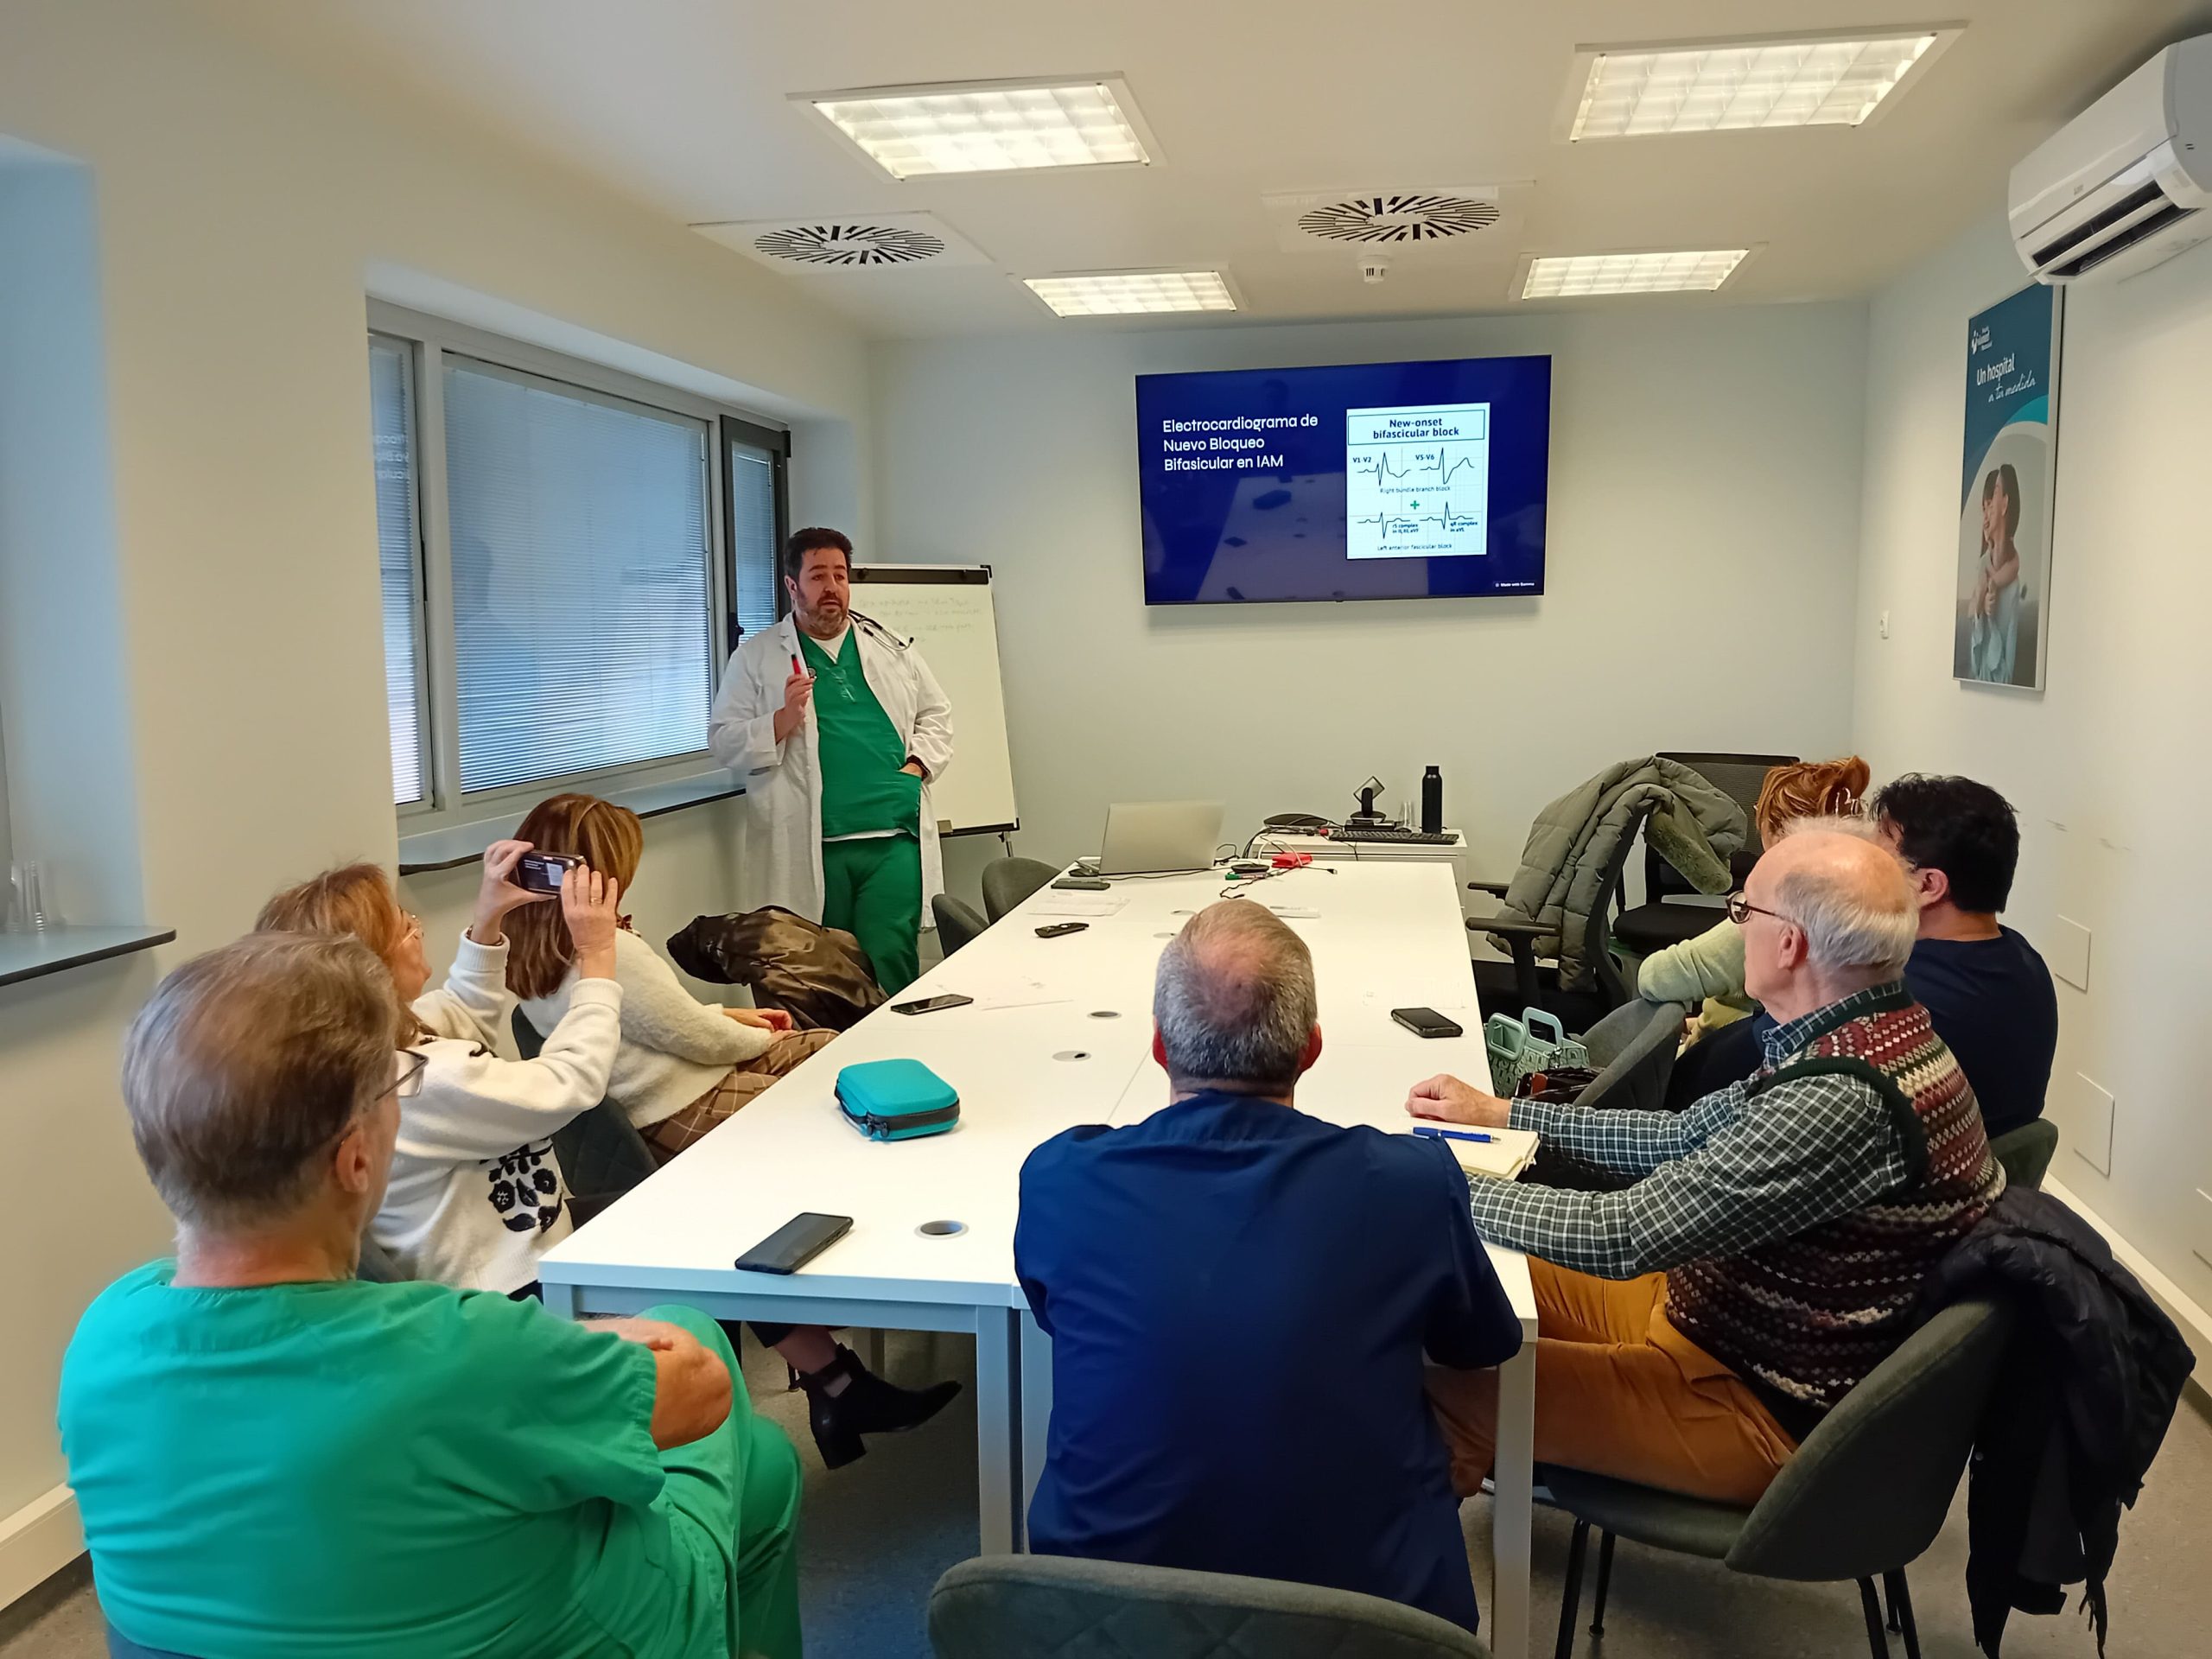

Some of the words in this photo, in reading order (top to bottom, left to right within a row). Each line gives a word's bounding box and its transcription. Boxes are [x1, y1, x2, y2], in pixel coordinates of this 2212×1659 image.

[1976, 368, 1986, 386] Un
[1987, 353, 2015, 382] hospital
[2005, 370, 2037, 397] medida
[1162, 416, 1298, 433] Electrocardiograma
[1300, 413, 1319, 427] de
[1389, 417, 1443, 428] New-onset
[1373, 429, 1430, 439] bifascicular
[1433, 426, 1459, 436] block
[1163, 439, 1207, 452] Nuevo
[1210, 436, 1265, 452] Bloqueo
[1164, 456, 1235, 471] Bifasicular
[1236, 457, 1253, 468] en
[1256, 454, 1284, 468] IAM
